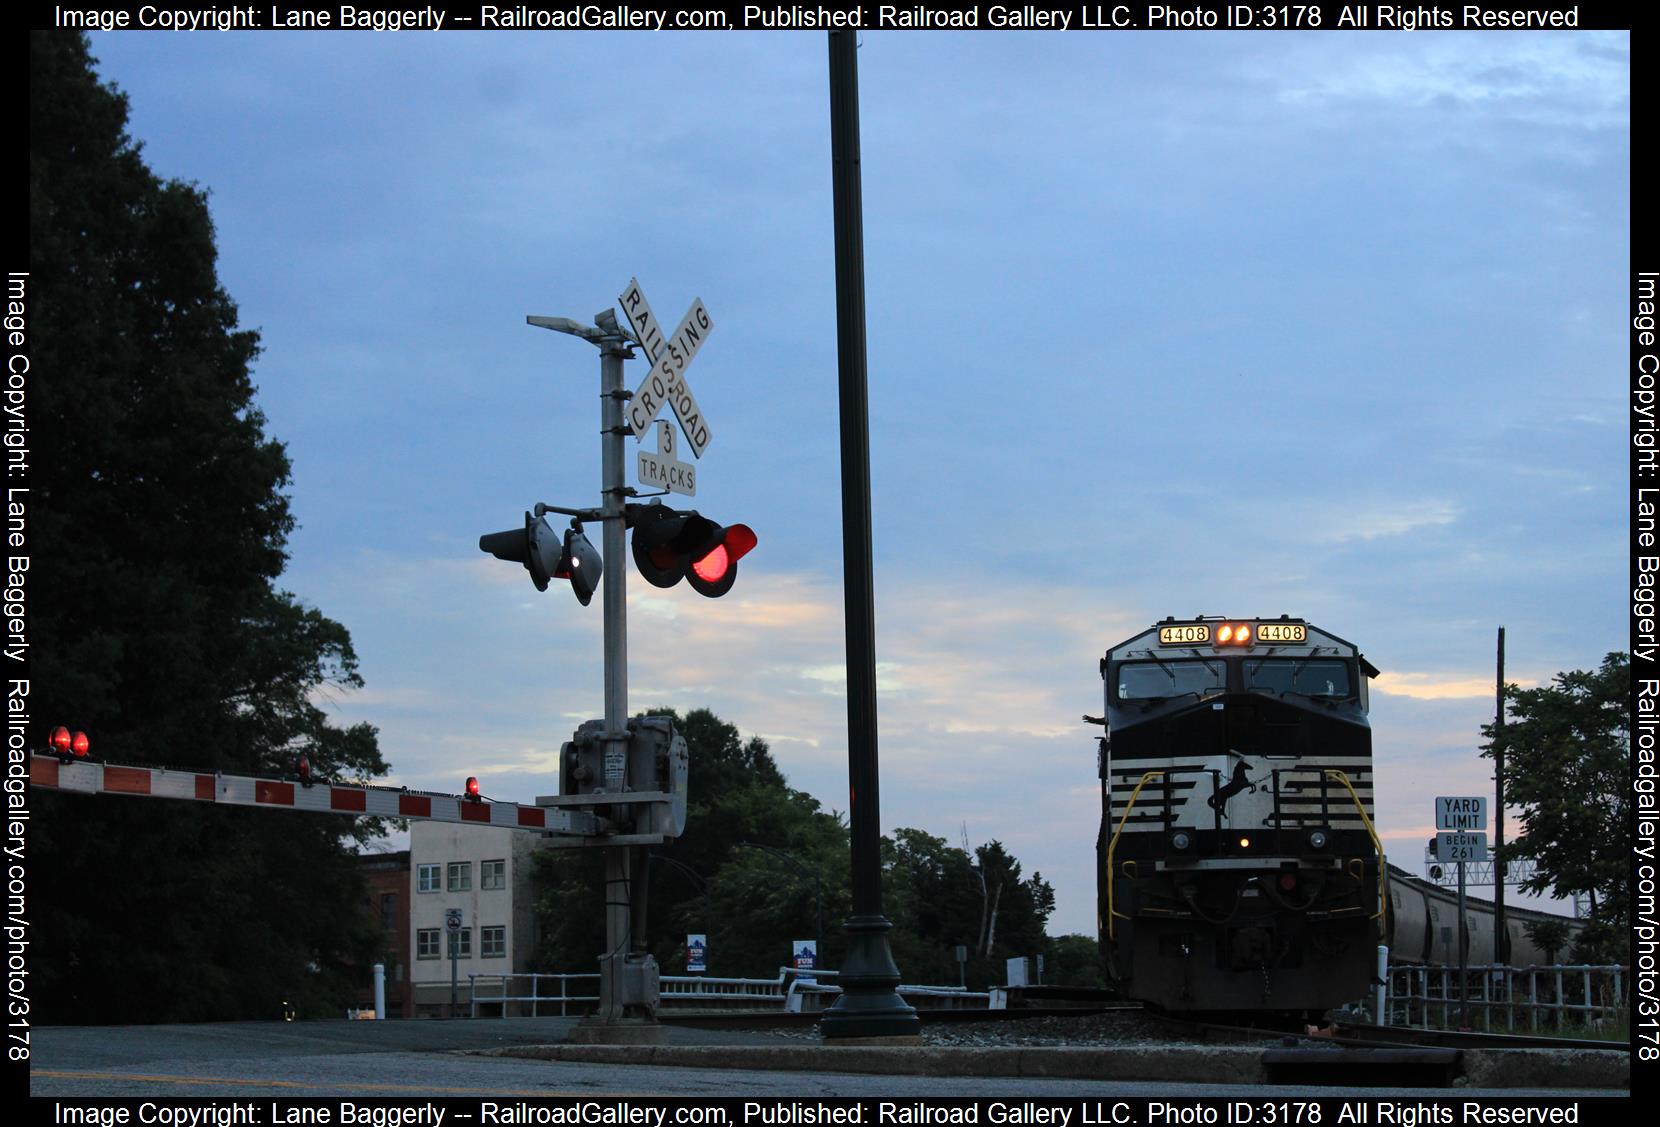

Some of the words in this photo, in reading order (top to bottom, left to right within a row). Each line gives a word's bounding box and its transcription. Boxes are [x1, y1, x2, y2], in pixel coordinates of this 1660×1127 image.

[632, 308, 708, 429] CROSSING
[664, 431, 672, 453] 3
[641, 459, 694, 489] TRACKS
[1164, 627, 1206, 642] 4408
[1261, 626, 1302, 640] 4408
[1445, 799, 1480, 813] YARD
[1445, 815, 1480, 828] LIMIT
[1446, 836, 1478, 845] BEGIN
[1451, 847, 1473, 858] 261
